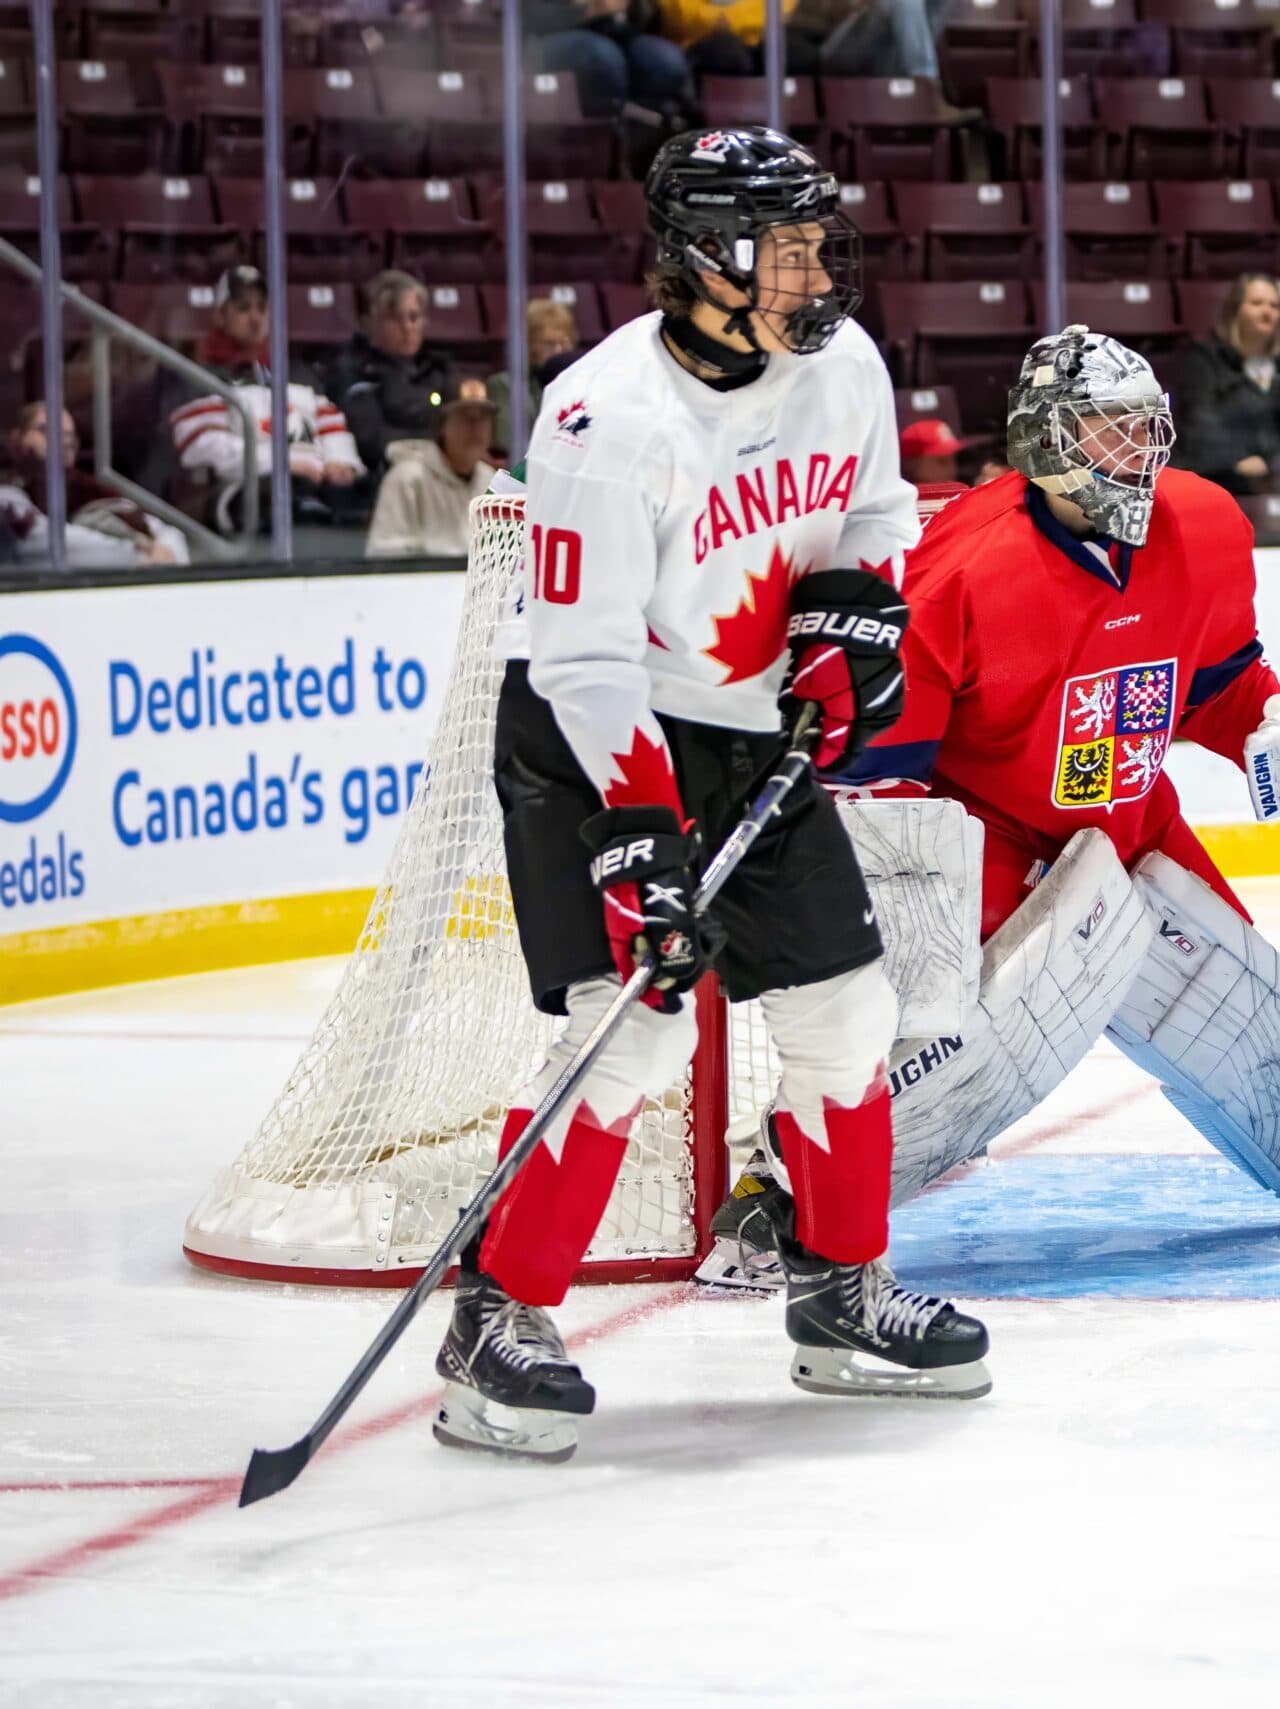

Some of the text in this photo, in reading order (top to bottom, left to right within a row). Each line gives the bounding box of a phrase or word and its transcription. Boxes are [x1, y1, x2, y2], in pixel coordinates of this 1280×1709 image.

[693, 453, 859, 566] CANADA
[531, 523, 583, 606] 10
[786, 611, 901, 649] BAUER
[1104, 613, 1141, 630] CCM
[108, 636, 427, 736] Dedicated to
[112, 752, 325, 848] Canada's
[1253, 752, 1279, 817] VAUGHN
[0, 831, 85, 908] edals
